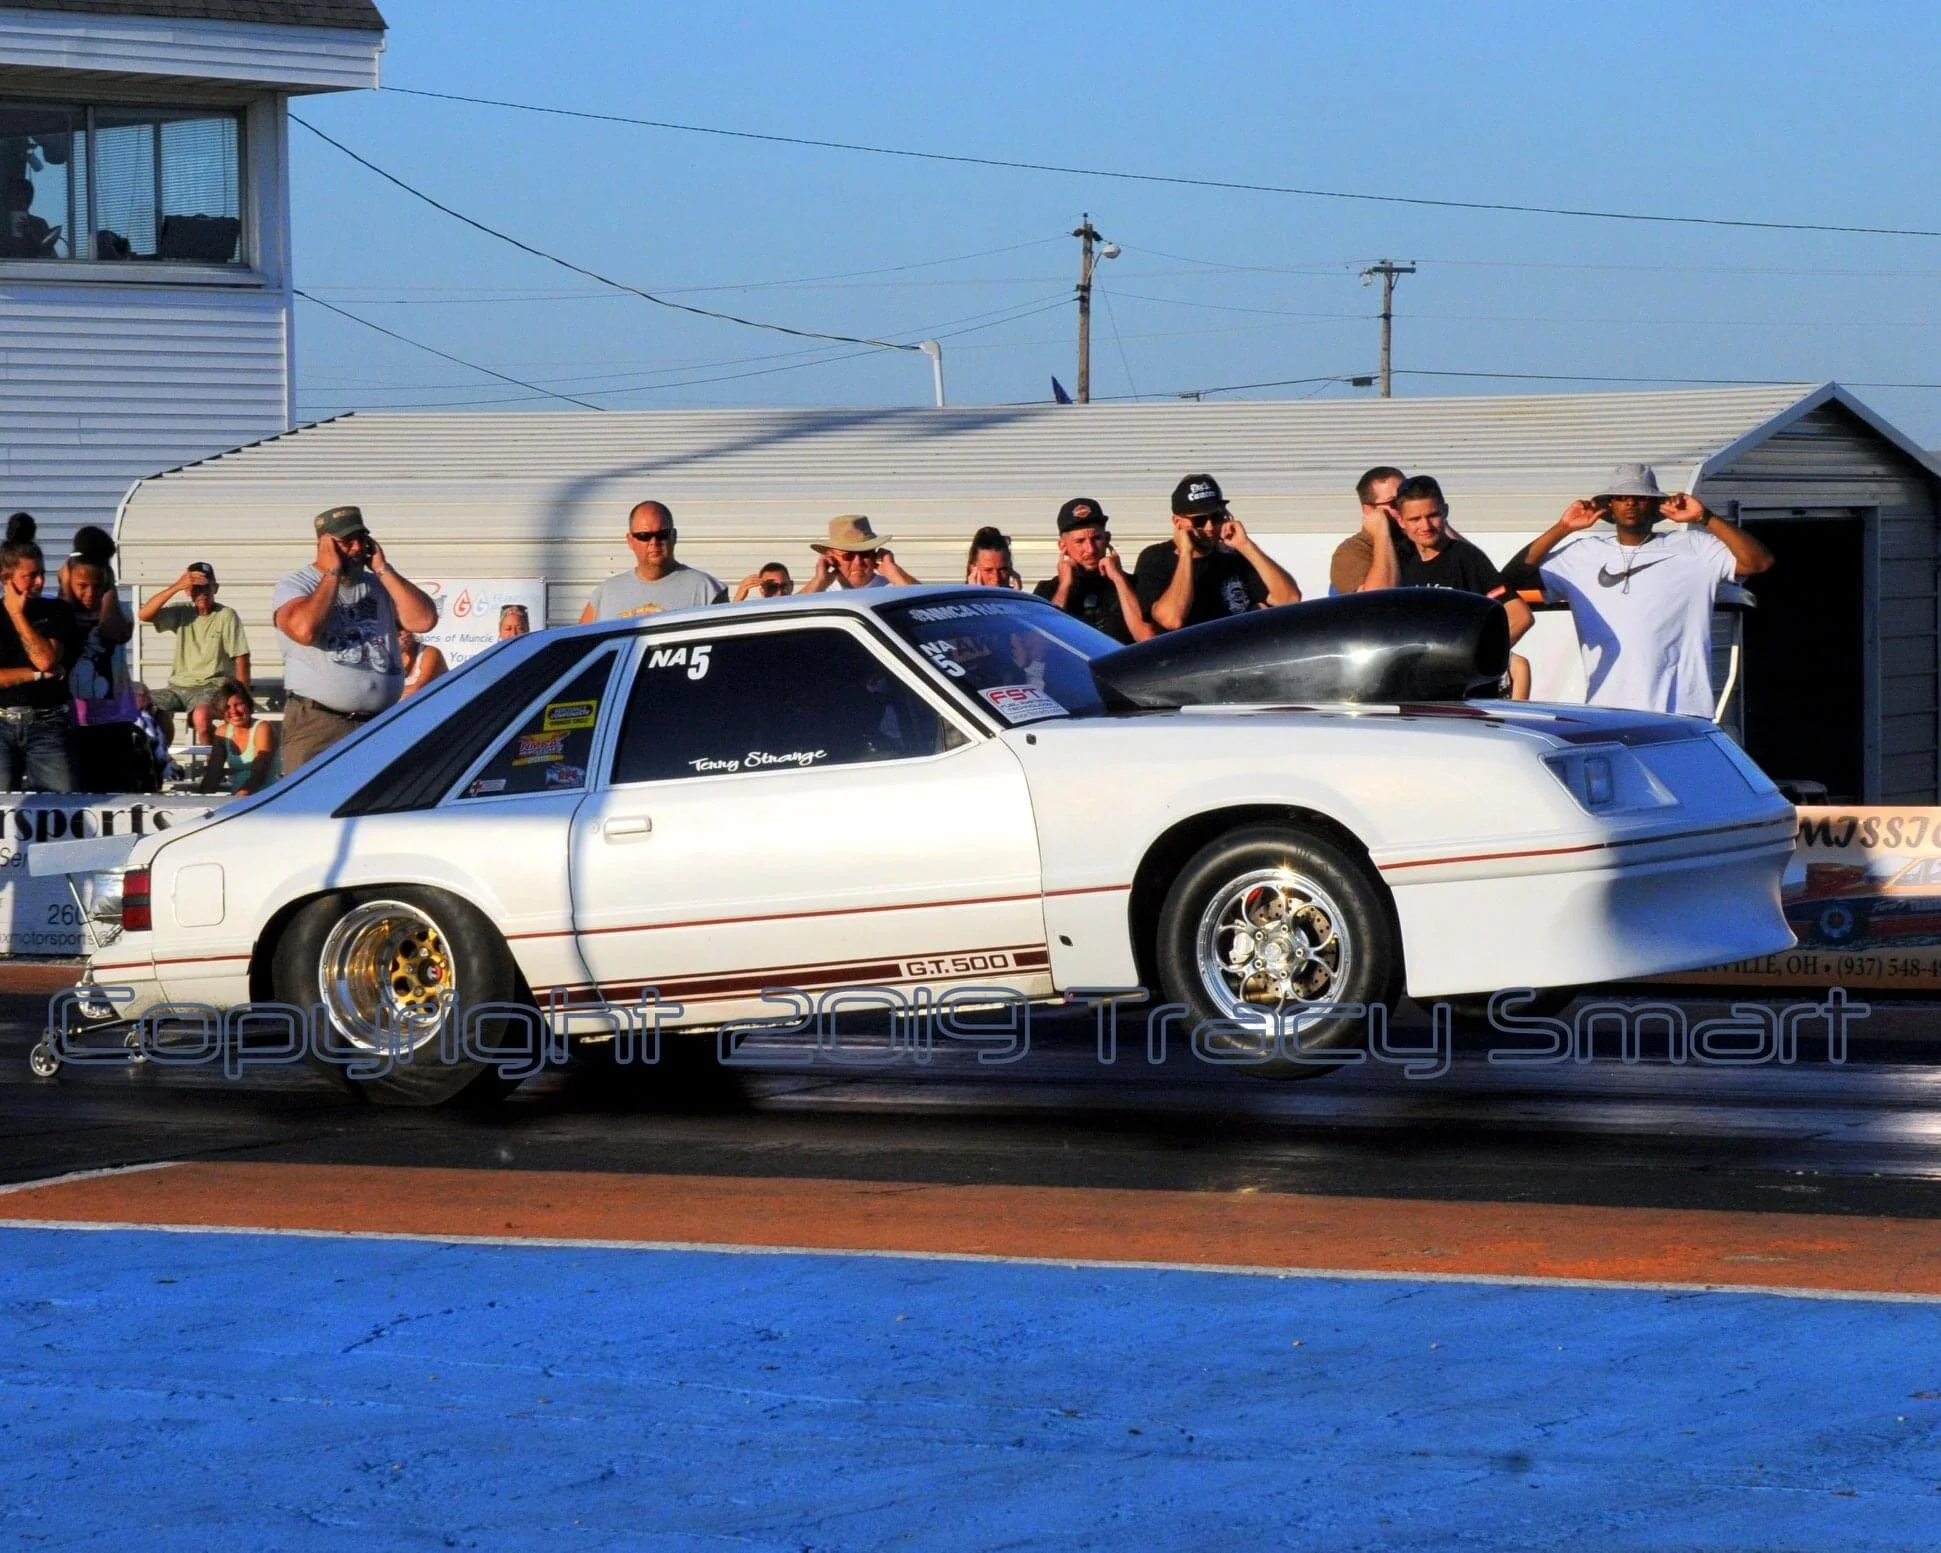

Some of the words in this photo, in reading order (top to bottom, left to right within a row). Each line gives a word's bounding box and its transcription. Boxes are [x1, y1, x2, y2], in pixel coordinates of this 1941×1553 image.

[919, 639, 957, 657] NA
[933, 654, 967, 678] 5
[988, 687, 1041, 705] FST
[744, 749, 828, 768] Strange
[1787, 956, 1817, 975] OH
[1837, 957, 1882, 979] (937)
